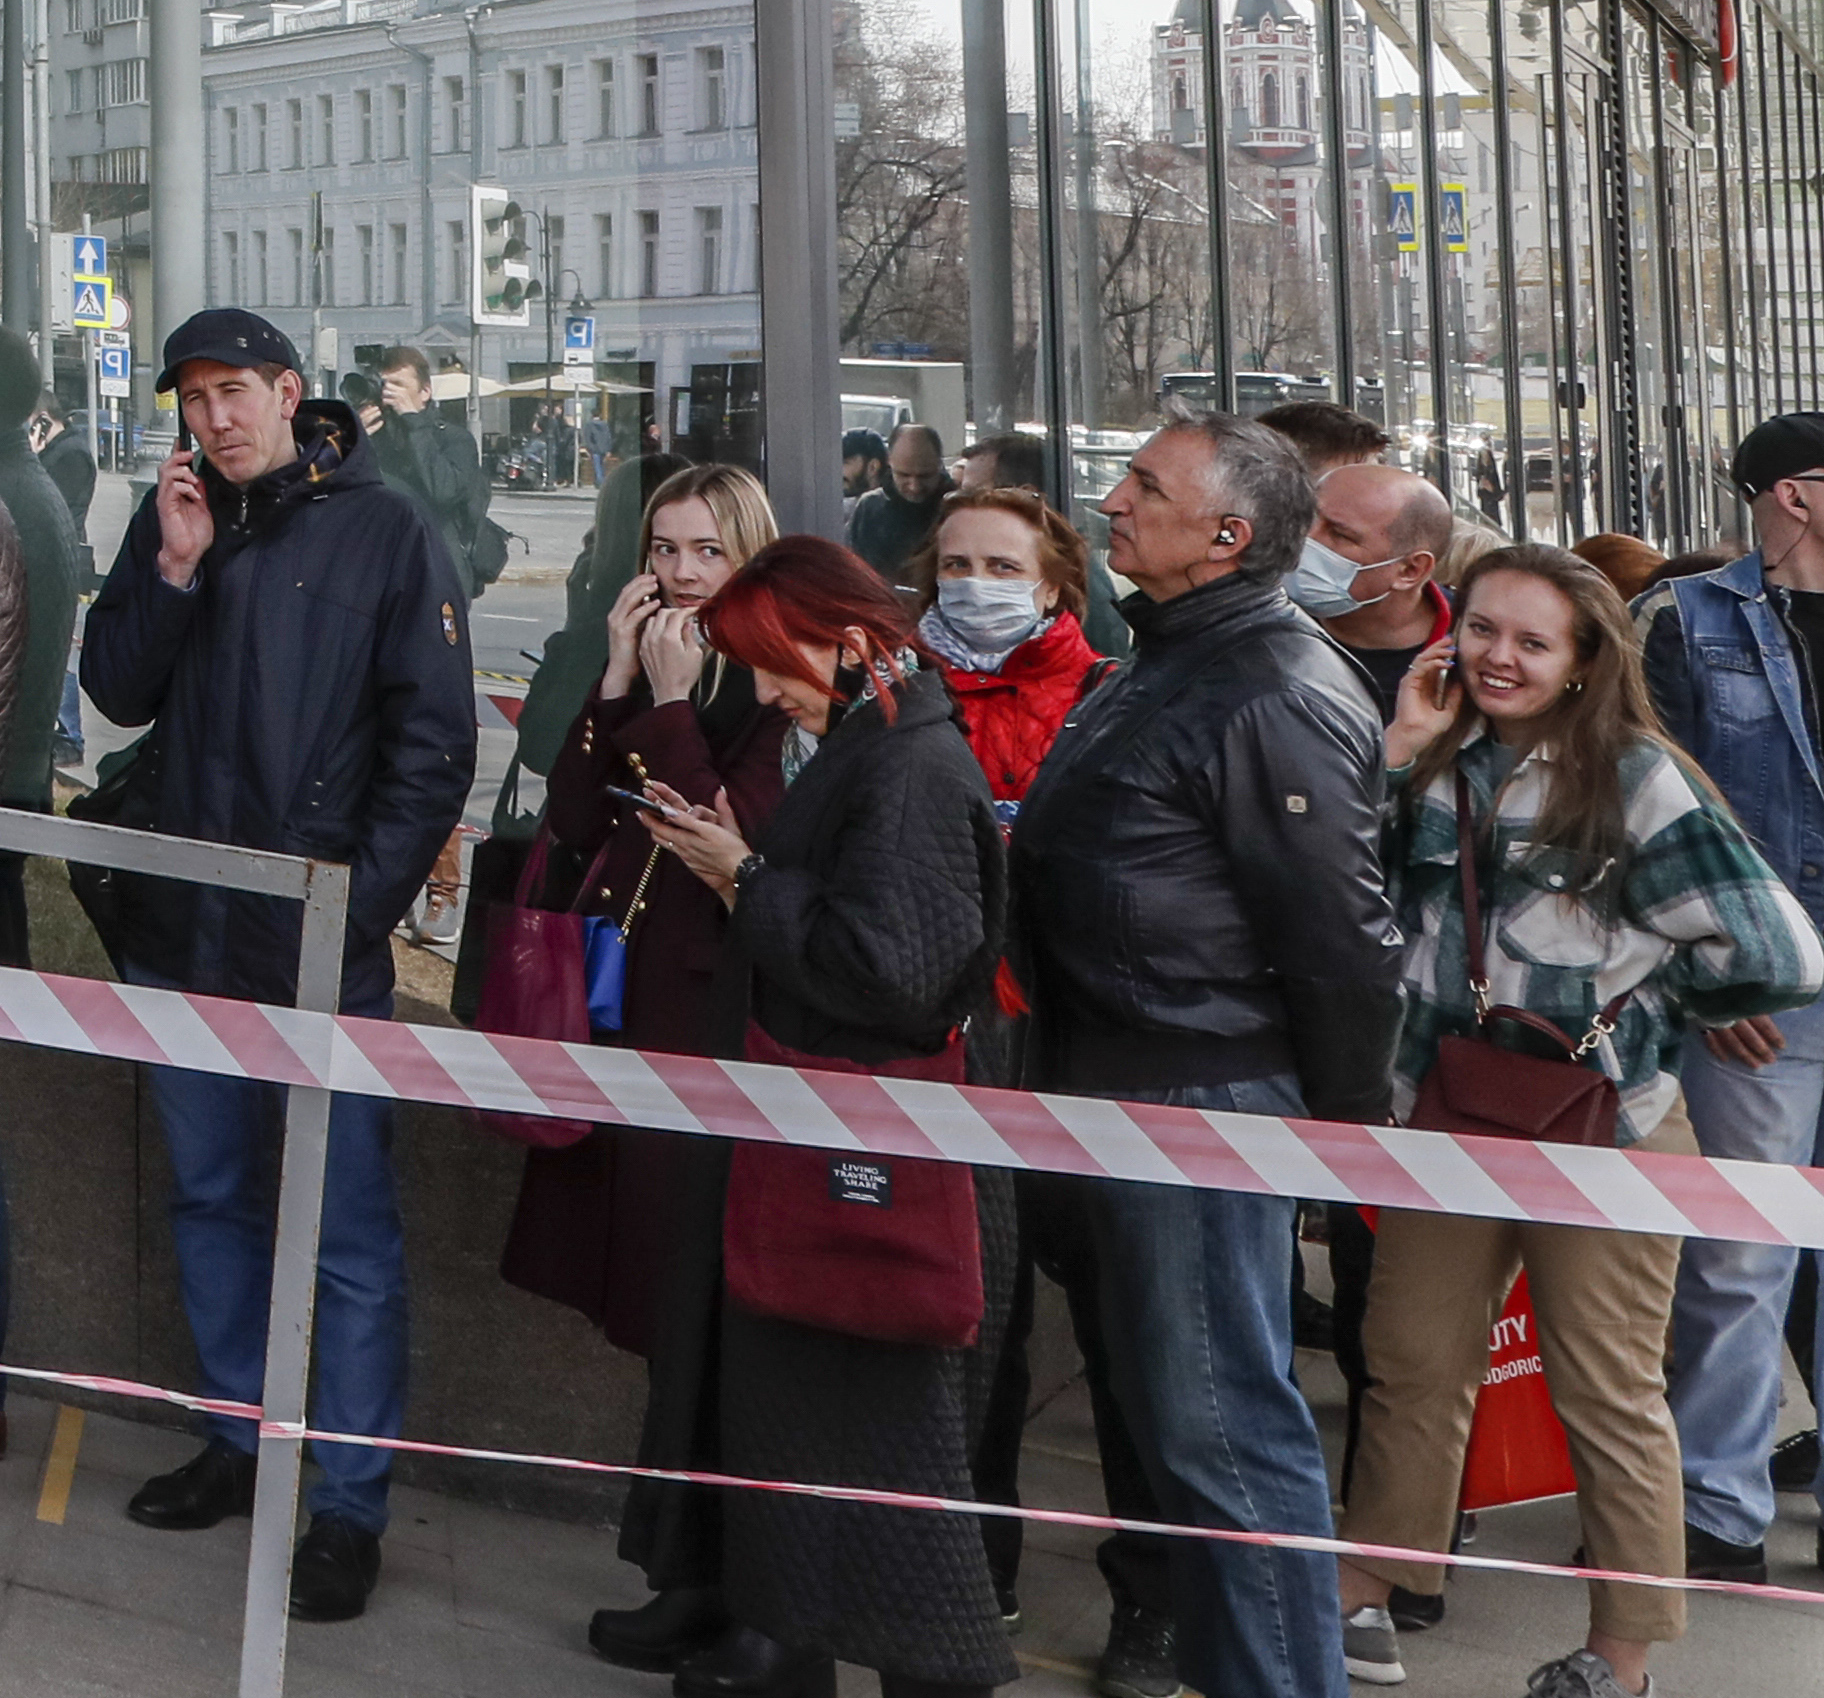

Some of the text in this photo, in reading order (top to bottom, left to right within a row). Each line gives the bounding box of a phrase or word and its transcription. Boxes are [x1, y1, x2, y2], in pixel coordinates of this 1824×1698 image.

[833, 1168, 887, 1184] TRAVELING
[842, 1163, 879, 1175] LIVING
[843, 1178, 879, 1190] SHARE
[1489, 1314, 1526, 1351] UTY
[1482, 1355, 1542, 1385] ODGORIC
